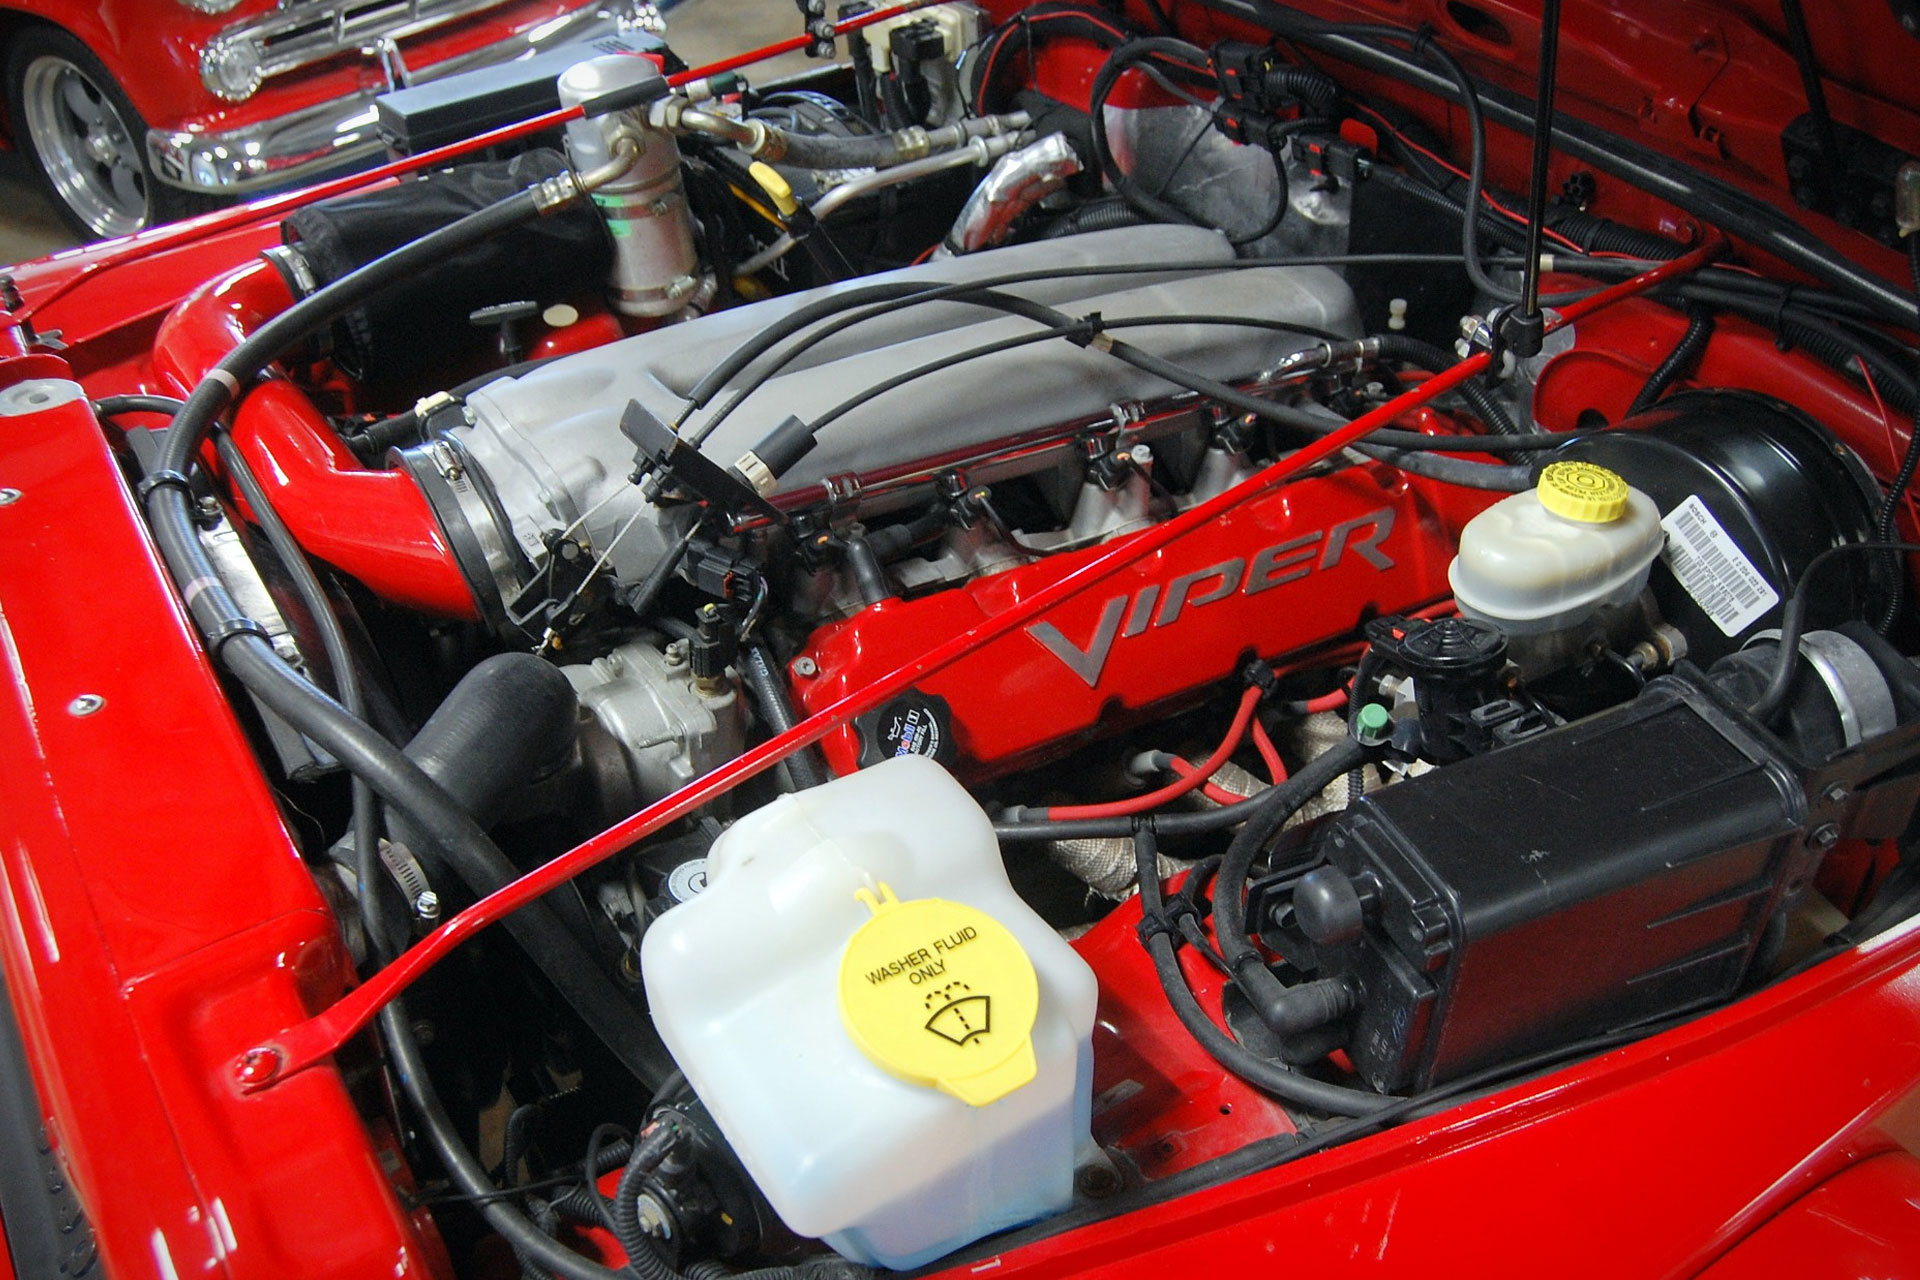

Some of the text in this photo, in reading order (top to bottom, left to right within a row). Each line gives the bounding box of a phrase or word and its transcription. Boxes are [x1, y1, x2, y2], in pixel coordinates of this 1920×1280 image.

[1688, 503, 1707, 525] BOSCH
[1024, 506, 1396, 689] VIPER
[895, 723, 916, 757] Mobil
[864, 926, 977, 985] WASHER FLUID
[908, 958, 946, 985] ONLY
